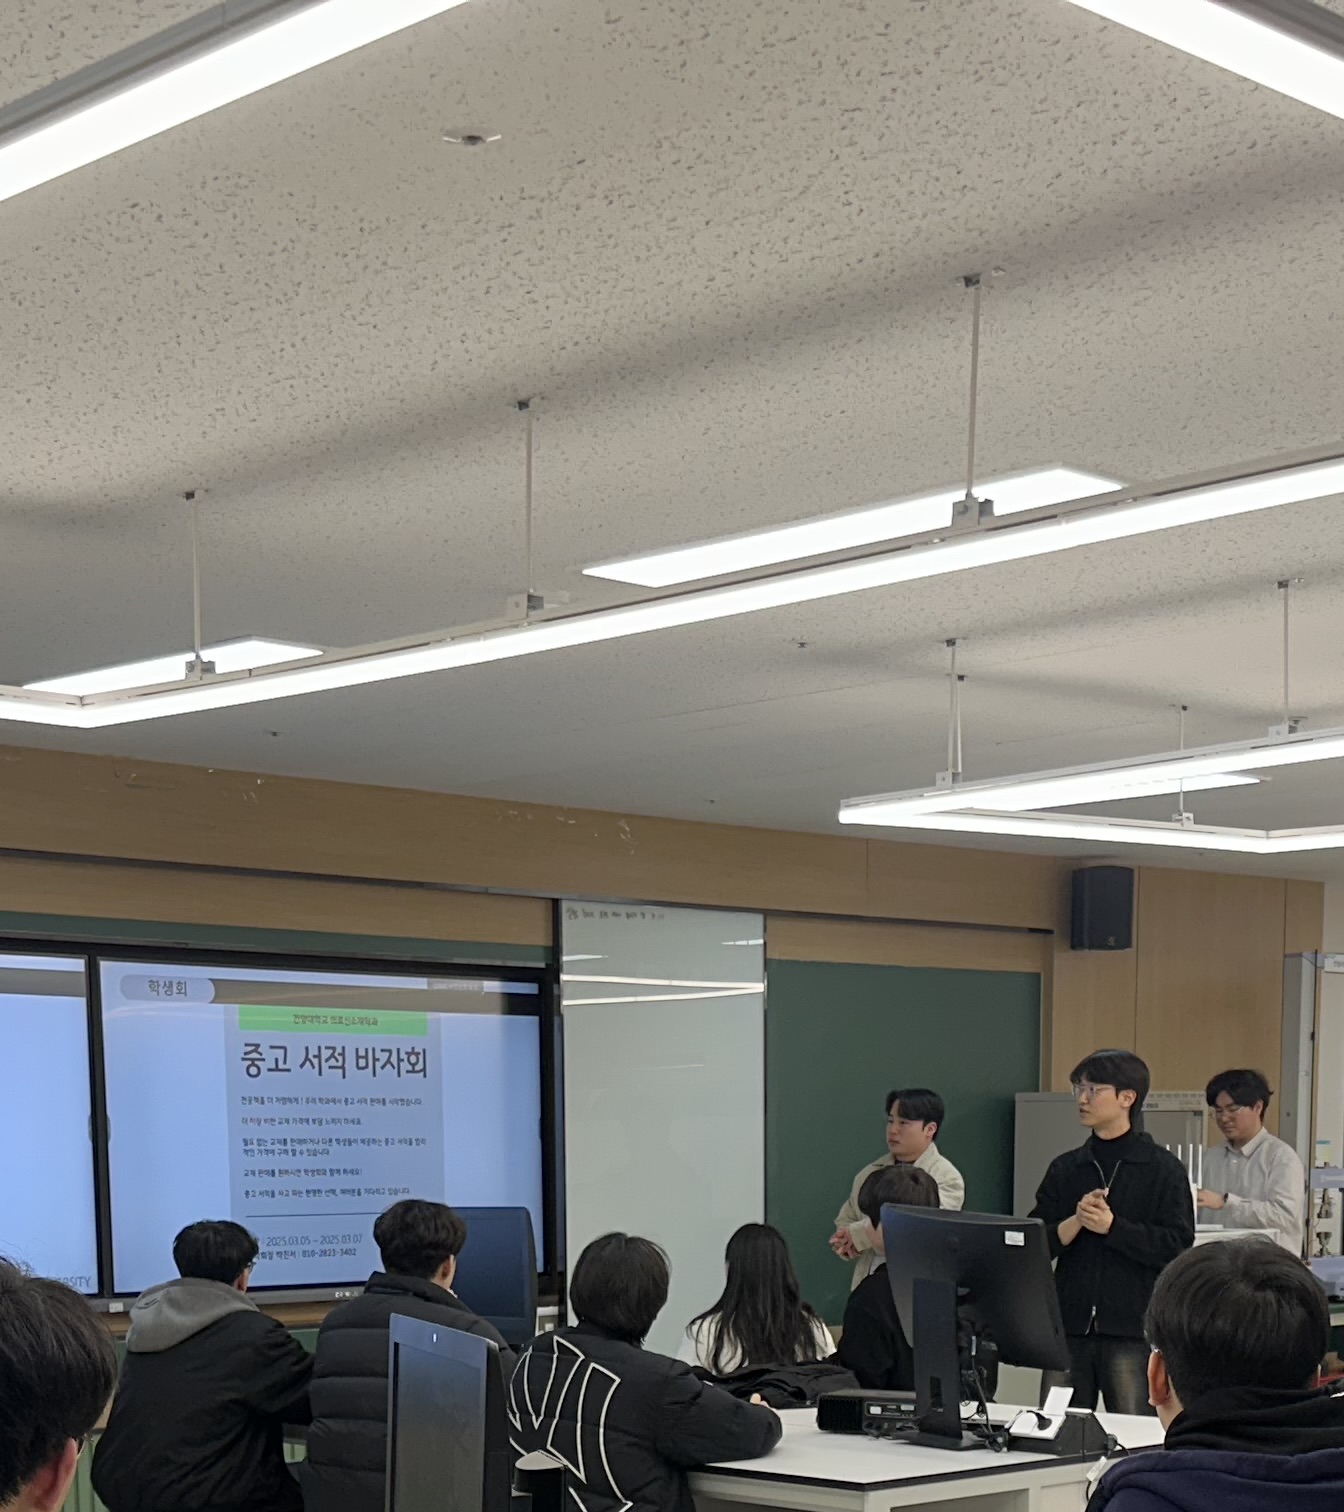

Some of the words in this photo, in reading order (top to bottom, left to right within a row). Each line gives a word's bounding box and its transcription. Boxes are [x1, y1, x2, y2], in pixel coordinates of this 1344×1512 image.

[148, 979, 188, 997] 학생회
[241, 1042, 292, 1079] 중고
[299, 1045, 346, 1080] 서적
[355, 1046, 428, 1079] 바자회
